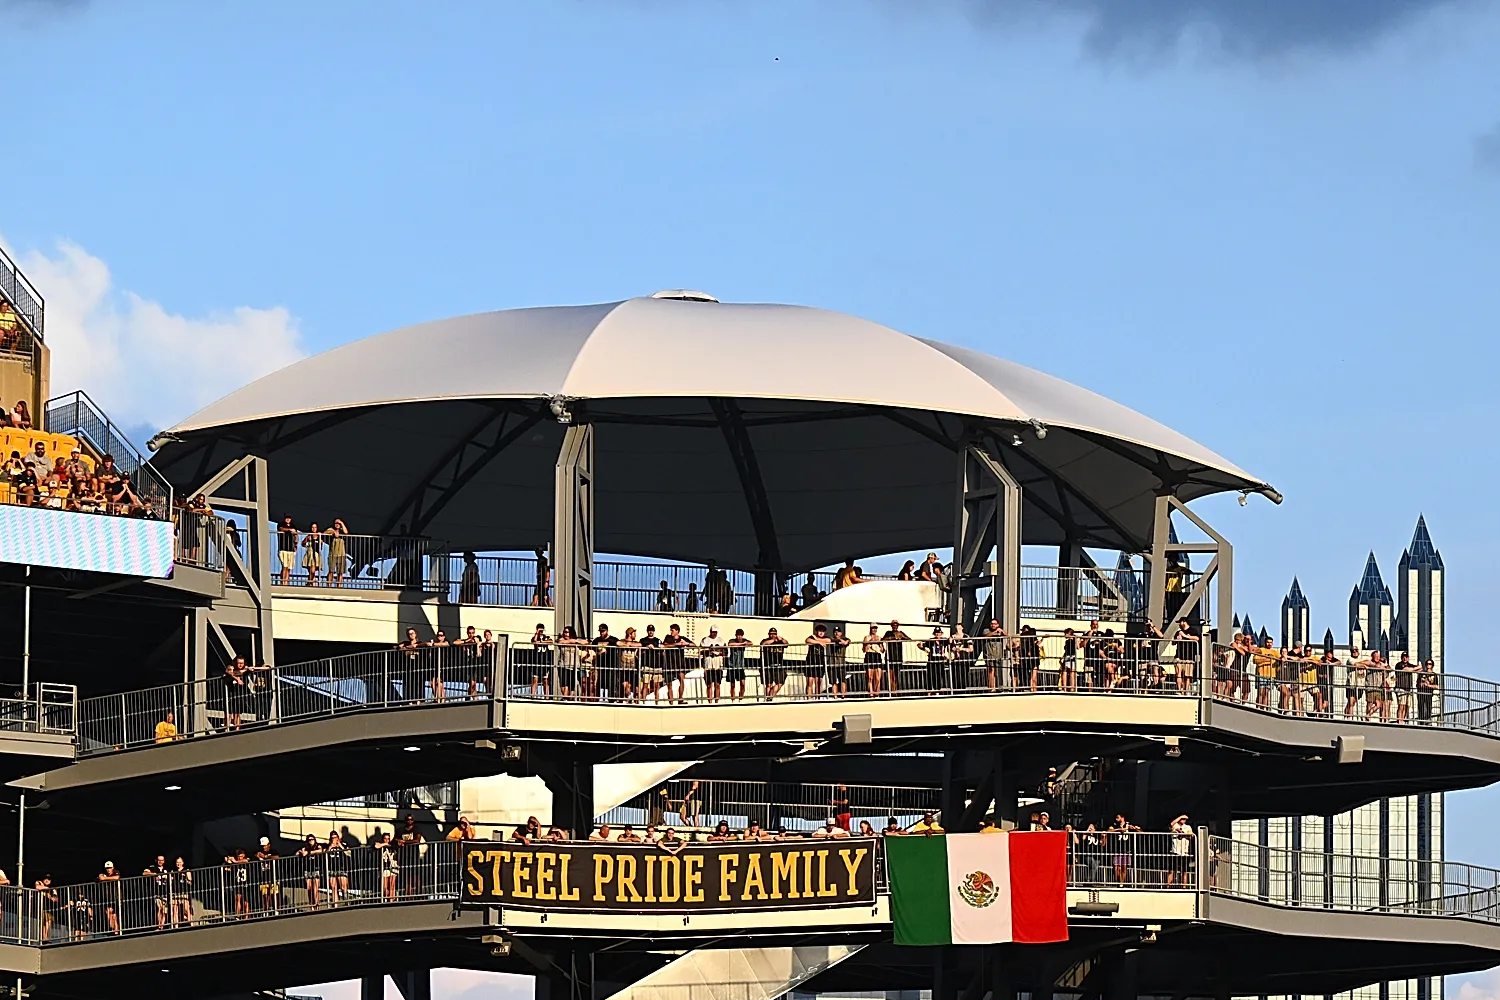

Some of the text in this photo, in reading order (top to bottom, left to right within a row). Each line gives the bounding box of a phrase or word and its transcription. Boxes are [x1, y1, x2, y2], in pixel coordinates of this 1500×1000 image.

[467, 848, 868, 903] STEEL PRIDE FAMILY
